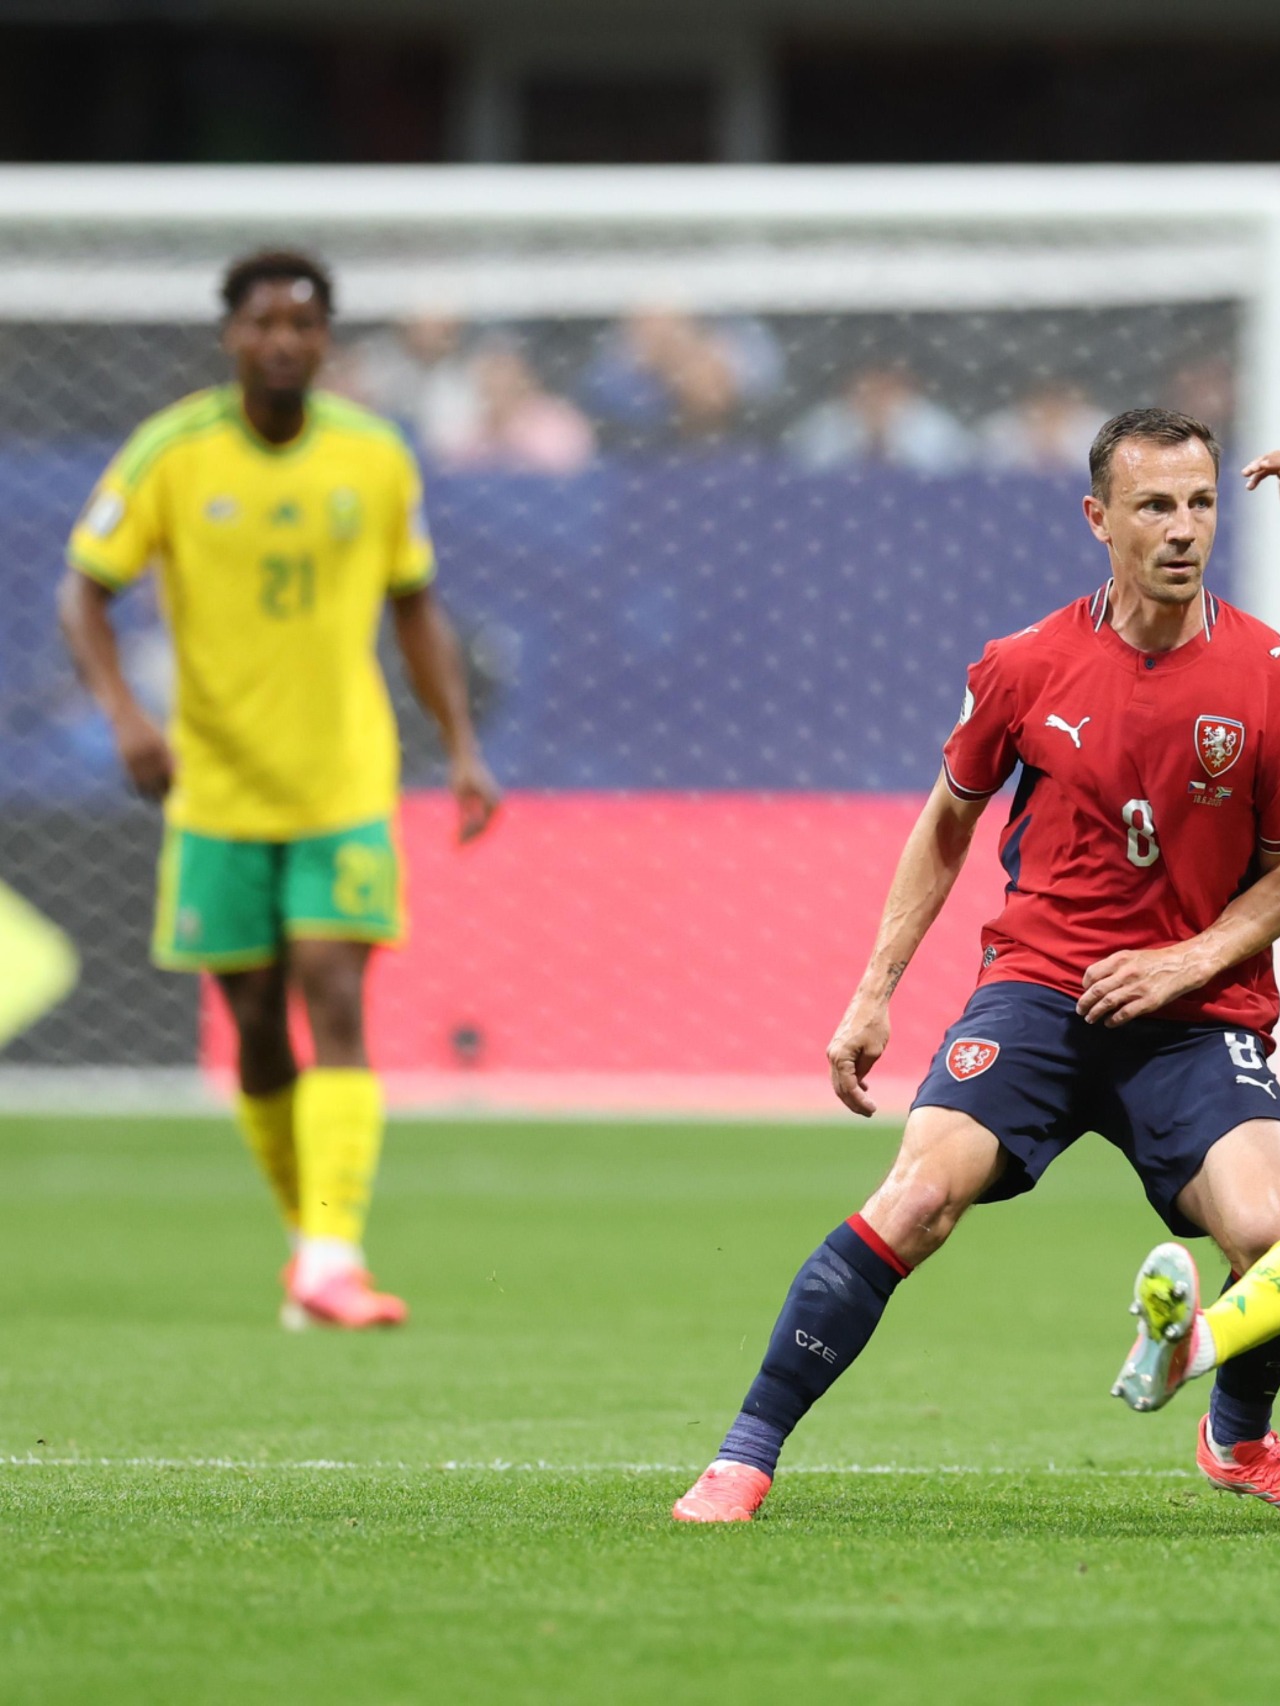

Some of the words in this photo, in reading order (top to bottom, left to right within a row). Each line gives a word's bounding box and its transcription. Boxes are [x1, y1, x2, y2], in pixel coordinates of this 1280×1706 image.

[258, 550, 316, 620] 21
[1122, 799, 1160, 867] 8
[1224, 1032, 1263, 1070] 8
[795, 1329, 838, 1364] CZE
